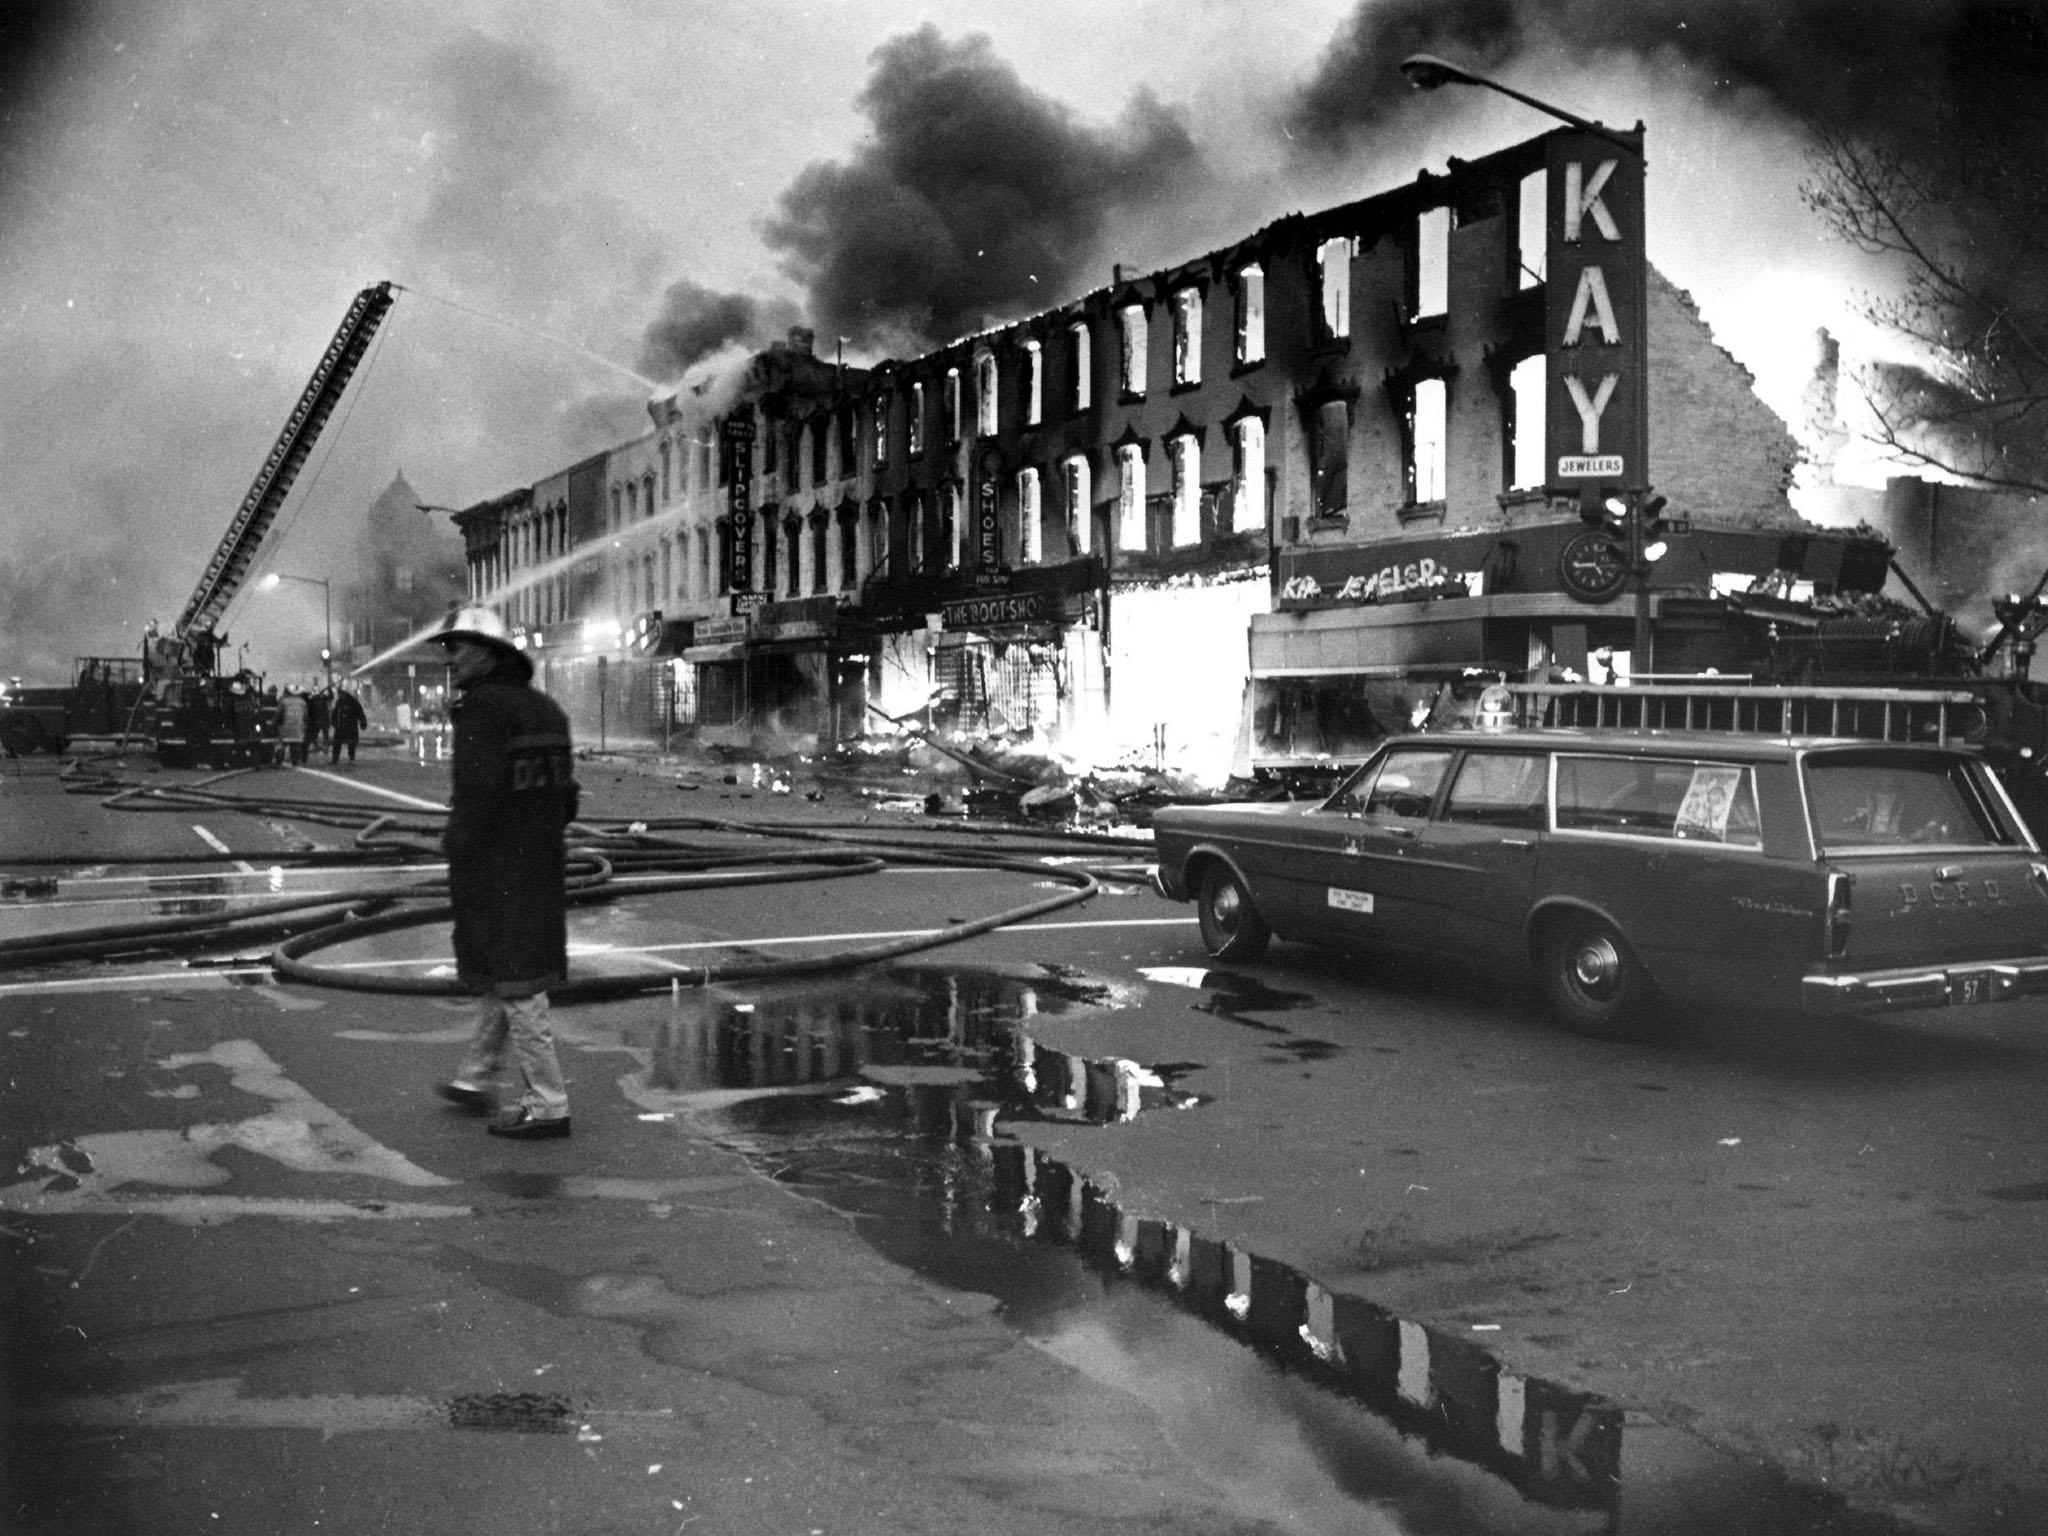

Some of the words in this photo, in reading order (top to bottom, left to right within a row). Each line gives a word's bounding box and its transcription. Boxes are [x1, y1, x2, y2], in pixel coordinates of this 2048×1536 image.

[1562, 158, 1623, 455] KAY
[1561, 459, 1621, 473] JEWELERS
[982, 482, 995, 563] SHOES
[1964, 980, 1979, 1001] 57
